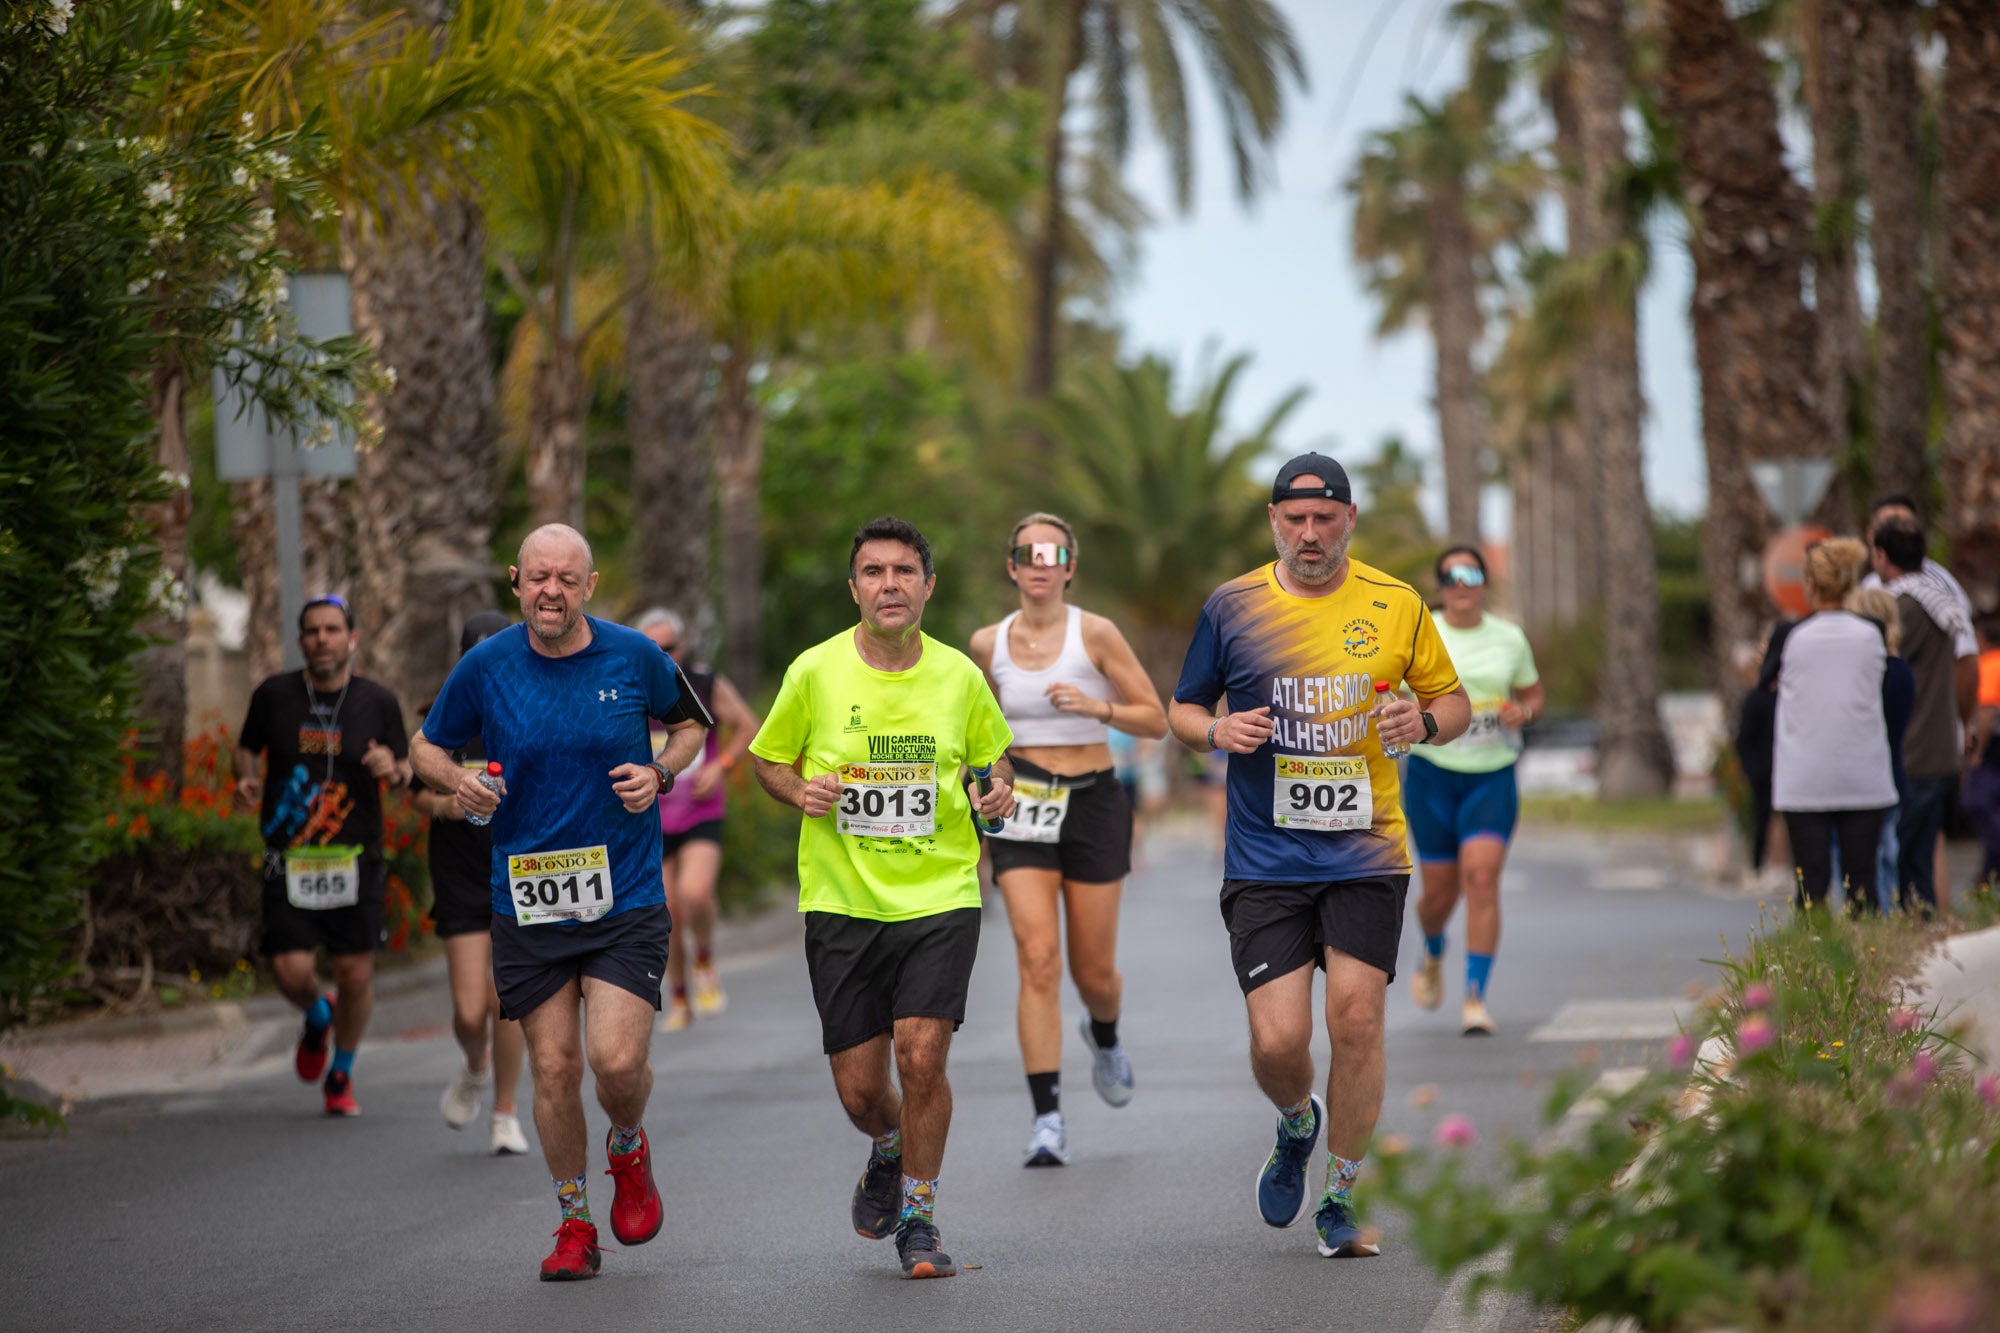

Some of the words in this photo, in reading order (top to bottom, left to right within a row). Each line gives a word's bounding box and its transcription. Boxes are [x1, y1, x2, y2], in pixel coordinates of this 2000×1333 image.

[1342, 618, 1378, 634] ATLETISMO
[1272, 673, 1370, 713] ATLETISMO
[1271, 707, 1369, 752] ALHENDÍN
[867, 735, 889, 754] VIII
[891, 735, 936, 744] CARRERA
[891, 744, 936, 753] NOCTURNA
[850, 766, 866, 779] 38
[1289, 761, 1304, 773] 38
[1304, 766, 1352, 776] FONDO
[866, 771, 915, 780] FONDO
[840, 787, 931, 817] 3013
[1289, 783, 1358, 812] 902
[522, 858, 537, 871] 38
[537, 857, 586, 871] FONDO
[301, 875, 345, 896] 565
[515, 872, 604, 907] 3011
